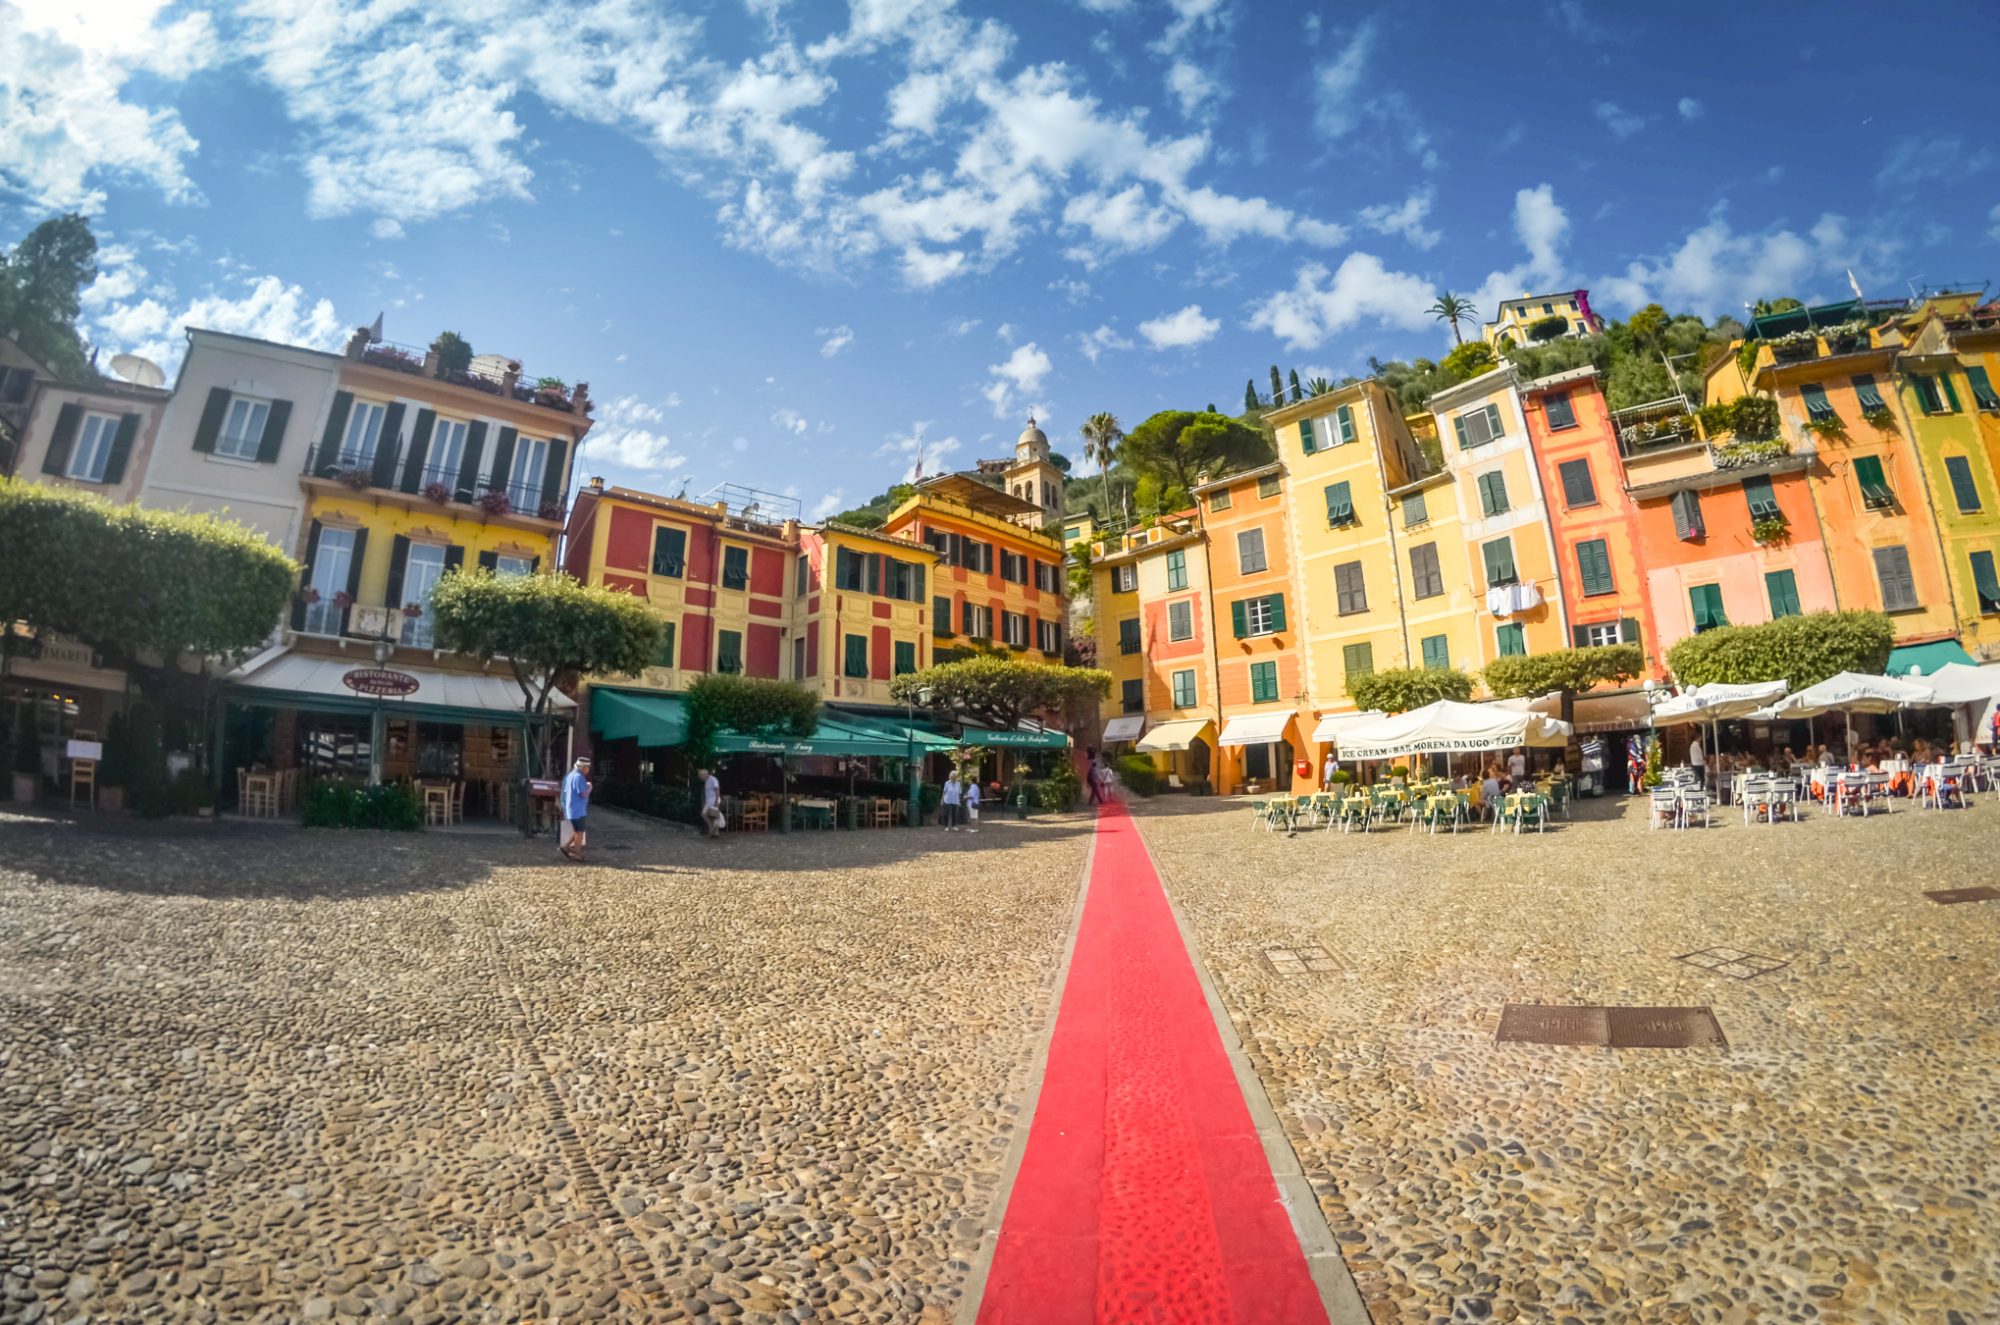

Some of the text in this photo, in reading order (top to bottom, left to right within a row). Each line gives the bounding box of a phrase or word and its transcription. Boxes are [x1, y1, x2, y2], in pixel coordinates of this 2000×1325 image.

[353, 671, 410, 684] RISTORANTE
[359, 684, 402, 693] PIZZERIA
[748, 740, 786, 750] Ristorante
[1342, 750, 1357, 758] ICE
[1357, 748, 1387, 757] CREAM
[1393, 744, 1411, 752] BAR
[1413, 741, 1452, 750] MORENA
[1453, 740, 1467, 748] DA
[1469, 739, 1490, 748] UGO
